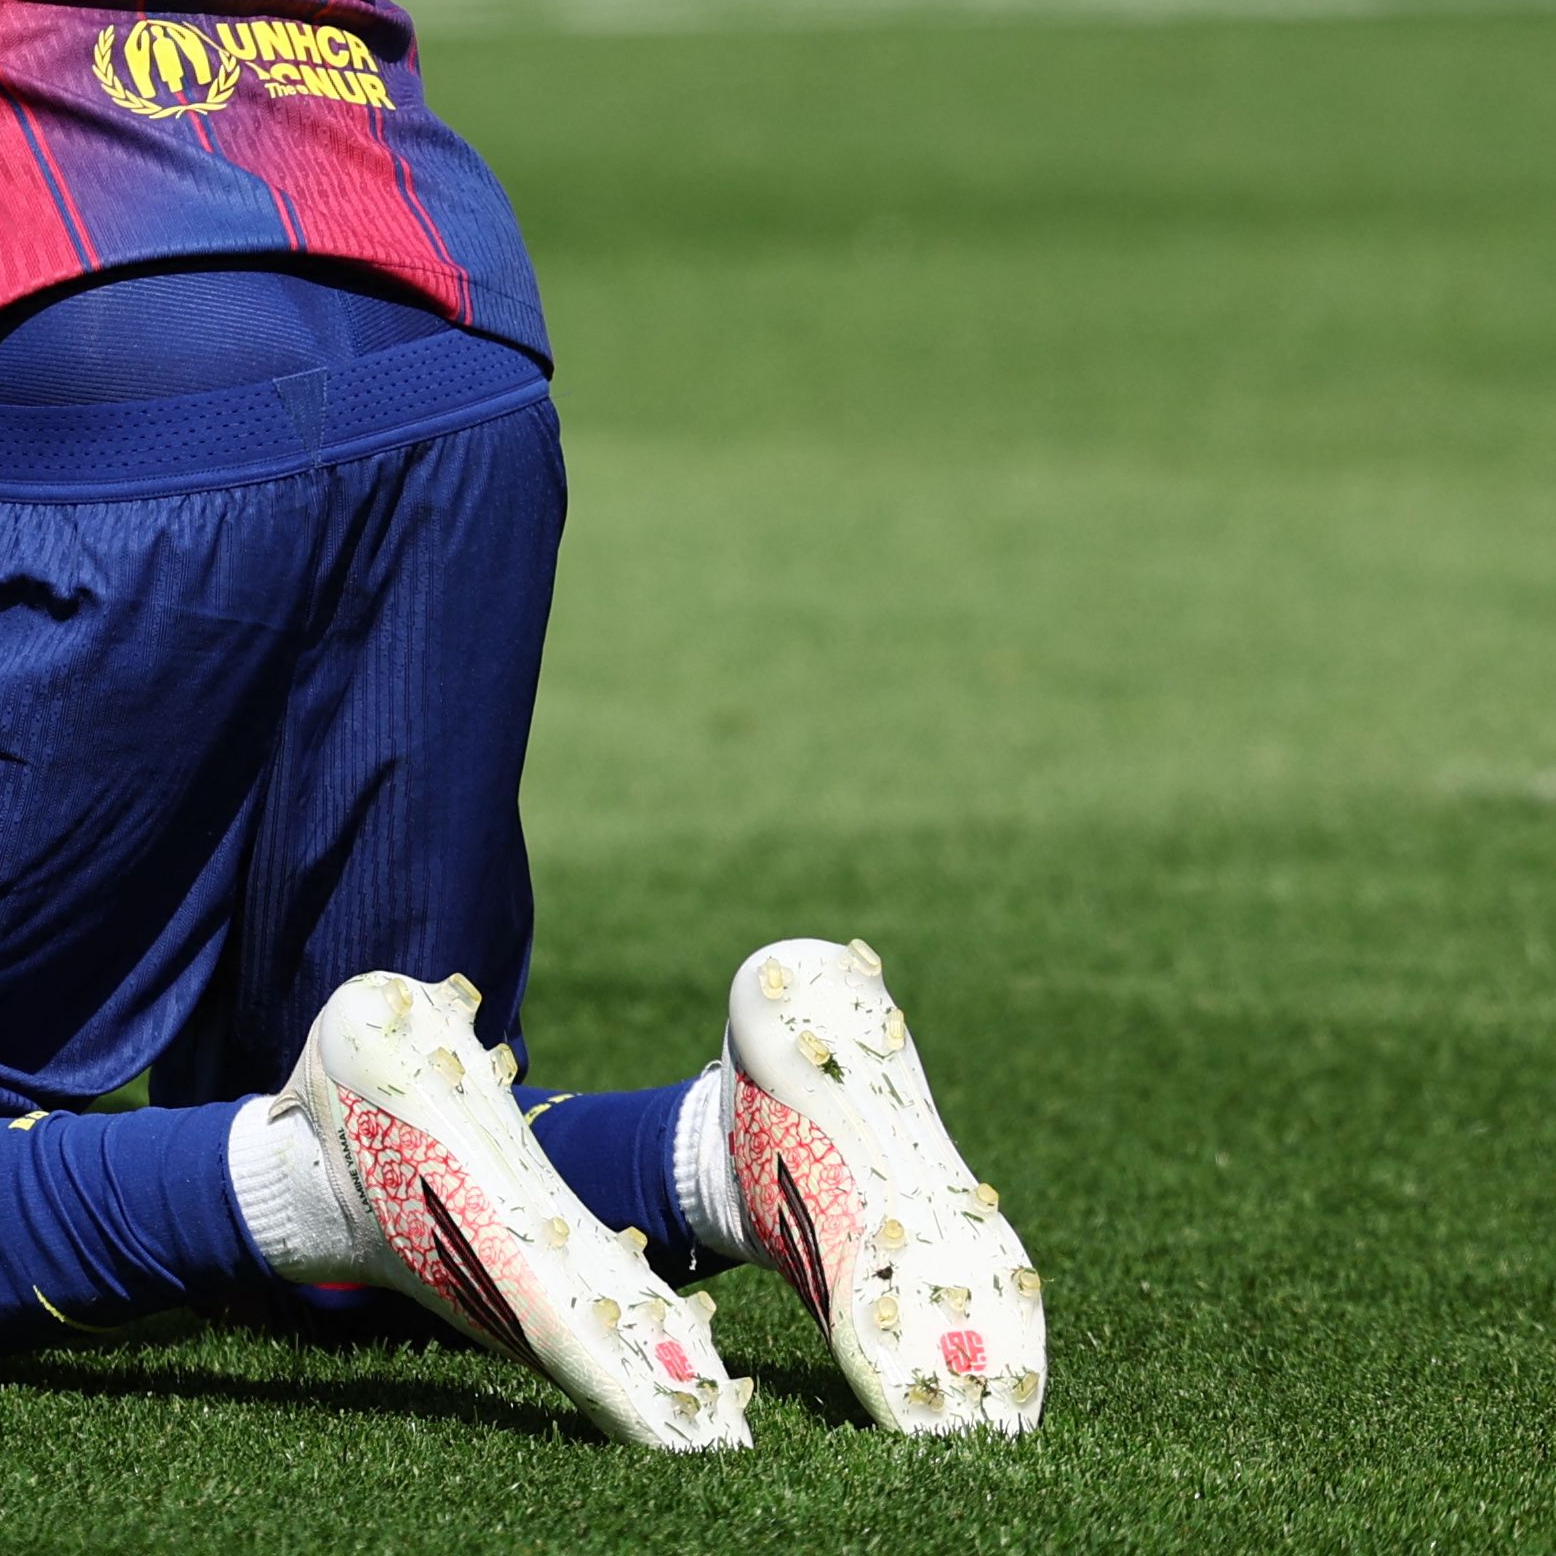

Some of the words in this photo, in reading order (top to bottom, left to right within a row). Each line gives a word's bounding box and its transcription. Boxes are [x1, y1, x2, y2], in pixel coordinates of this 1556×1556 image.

[216, 20, 379, 72] UNHCR
[338, 1127, 355, 1167] YAMAL
[349, 1169, 372, 1214] LAMINE
